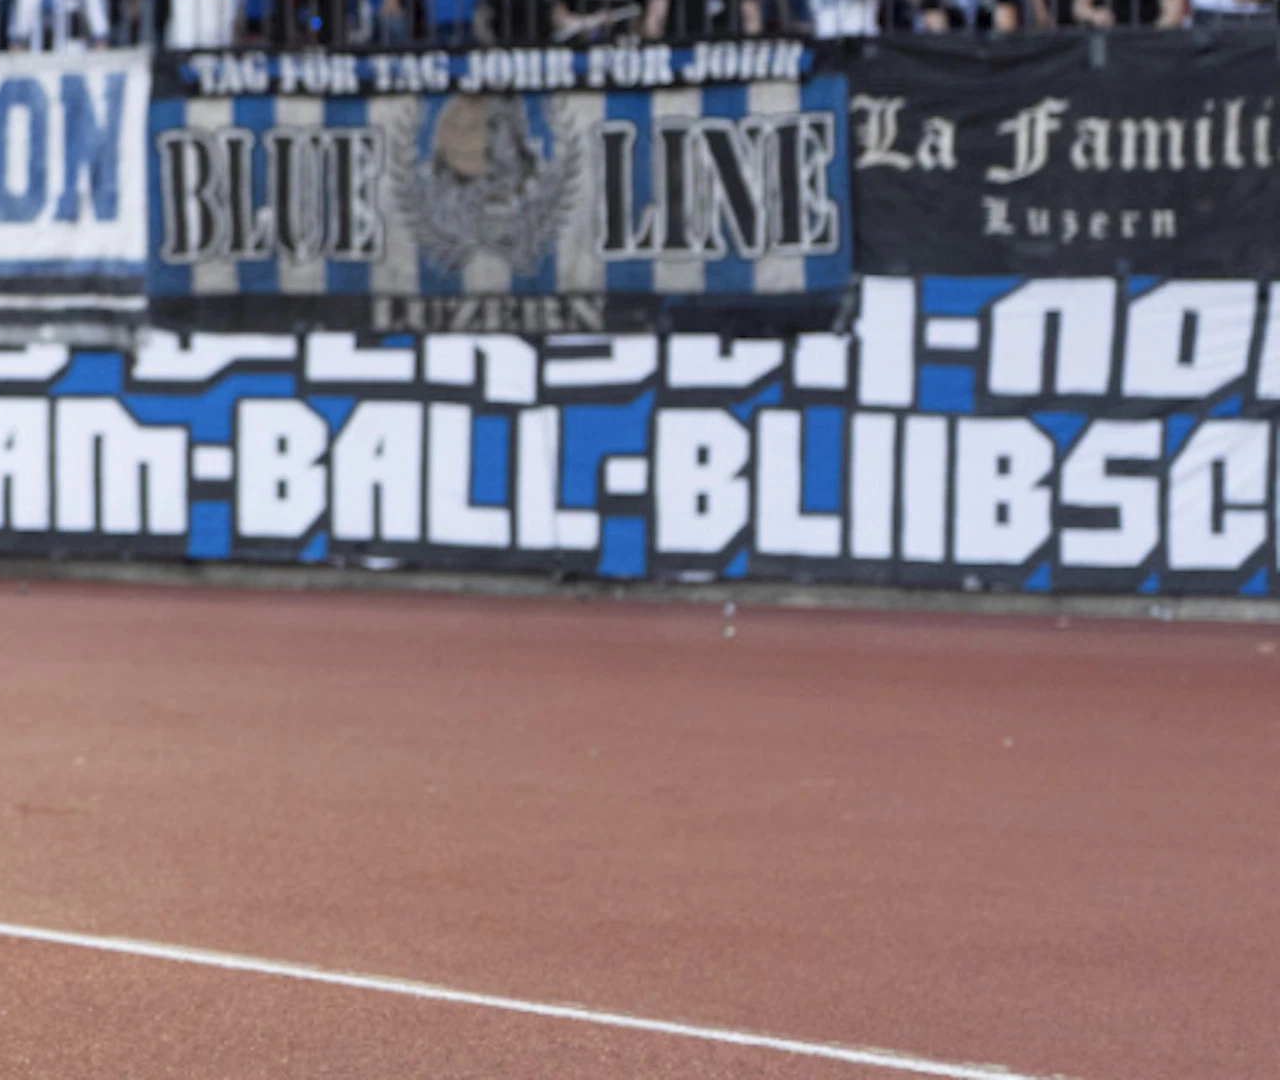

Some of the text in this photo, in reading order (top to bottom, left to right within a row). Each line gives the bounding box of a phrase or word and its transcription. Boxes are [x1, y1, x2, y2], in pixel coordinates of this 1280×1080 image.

[191, 51, 269, 94] TAG
[371, 51, 450, 92] TAG
[850, 93, 957, 171] La
[158, 112, 839, 263] BLUE LINE
[982, 196, 1177, 243] Luzern
[372, 295, 606, 332] LUZERN
